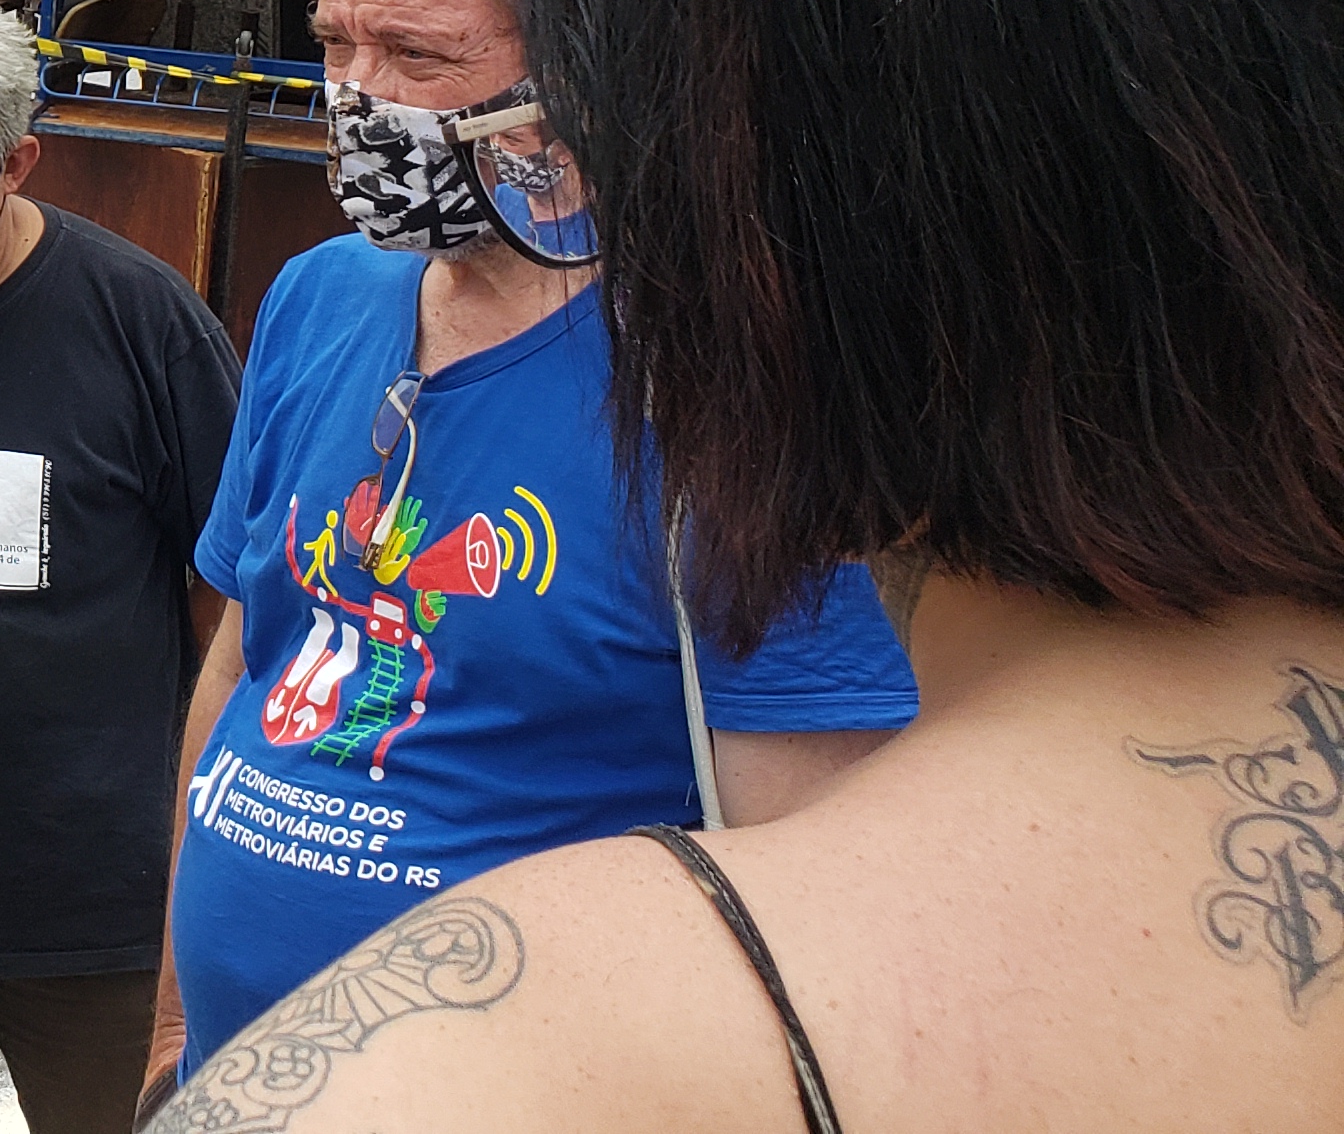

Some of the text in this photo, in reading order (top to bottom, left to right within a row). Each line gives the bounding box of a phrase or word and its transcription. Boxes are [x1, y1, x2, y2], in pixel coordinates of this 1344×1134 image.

[6, 554, 20, 565] de
[224, 787, 389, 853] METROVIÁRIOS E
[238, 764, 406, 830] CONGRESSO DOS
[214, 814, 441, 889] METROVIÁRIAS DO RS
